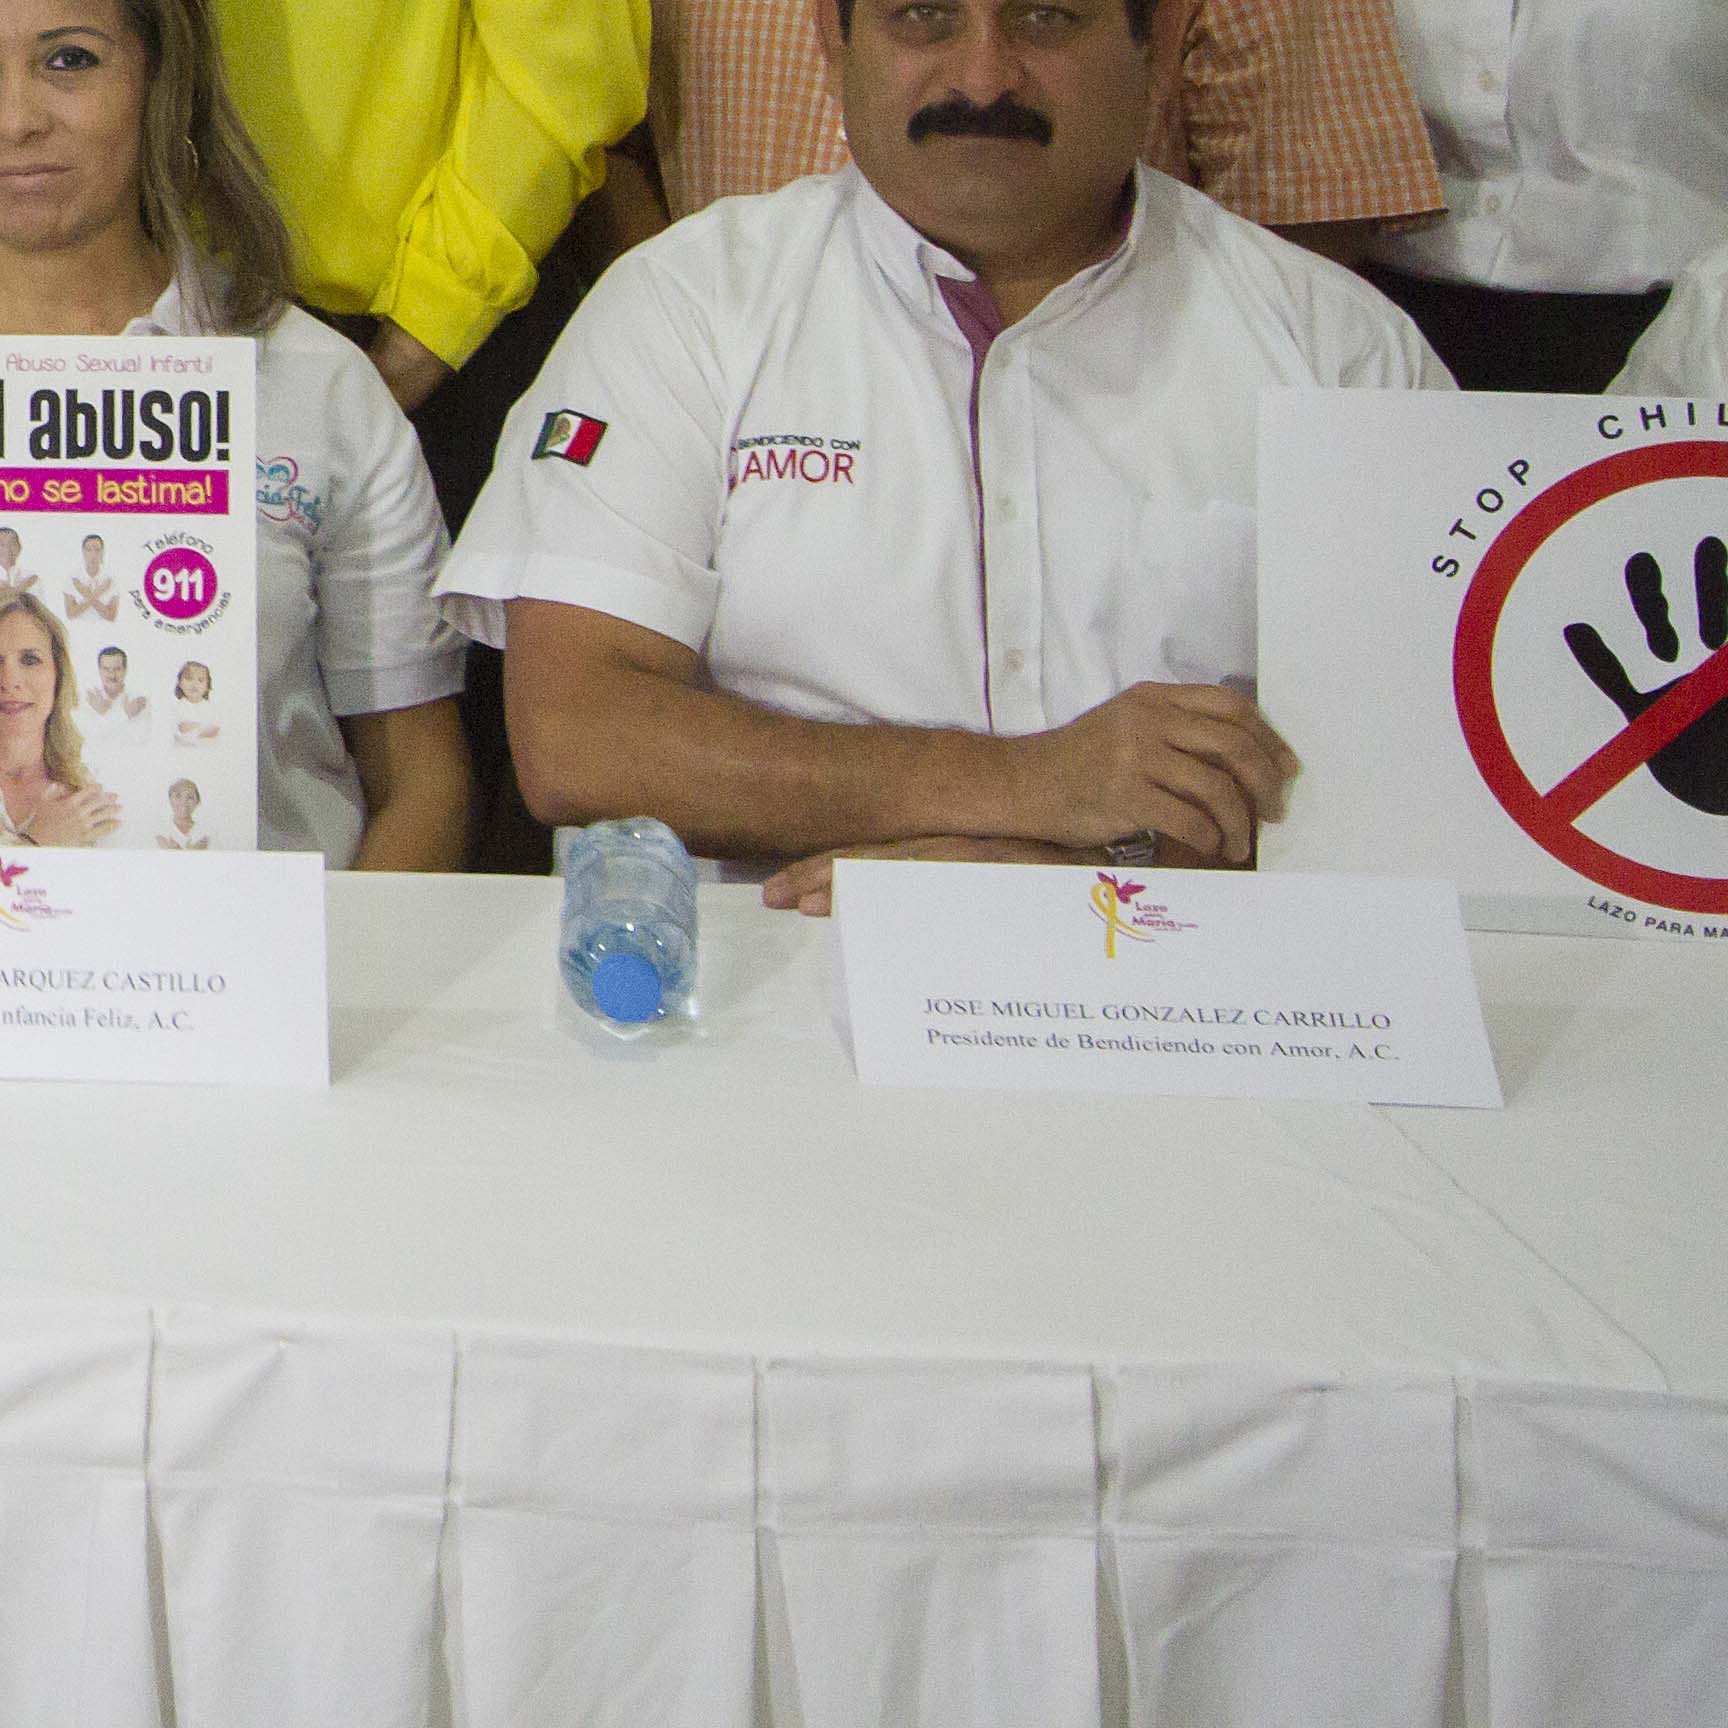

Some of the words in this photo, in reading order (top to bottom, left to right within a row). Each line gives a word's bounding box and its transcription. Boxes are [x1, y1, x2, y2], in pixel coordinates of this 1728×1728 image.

[6, 353, 66, 373] Abuso
[76, 354, 142, 374] Sexual
[149, 355, 214, 375] Infantil
[29, 387, 231, 462] abuso!
[830, 438, 861, 451] CON
[741, 448, 854, 484] AMOR
[42, 479, 81, 504] se
[96, 473, 213, 506] lastima!
[1431, 458, 1532, 579] STOP
[1597, 401, 1728, 440] CHIL
[152, 567, 204, 602] 911
[1587, 895, 1637, 922] LAZO
[1645, 916, 1694, 937] PARA
[1704, 926, 1728, 939] MA
[102, 970, 226, 993] CASTILLO
[923, 998, 984, 1016] JOSE
[991, 1000, 1094, 1020] MIGUEL
[1102, 1003, 1244, 1023] GONZALEZ
[1253, 1010, 1391, 1029] CARRILLO
[927, 1028, 1038, 1048] Presidente
[1045, 1031, 1070, 1049] de
[1077, 1033, 1215, 1054] Bendiciendo
[1222, 1041, 1262, 1056] con
[1348, 1042, 1400, 1061] A.C.
